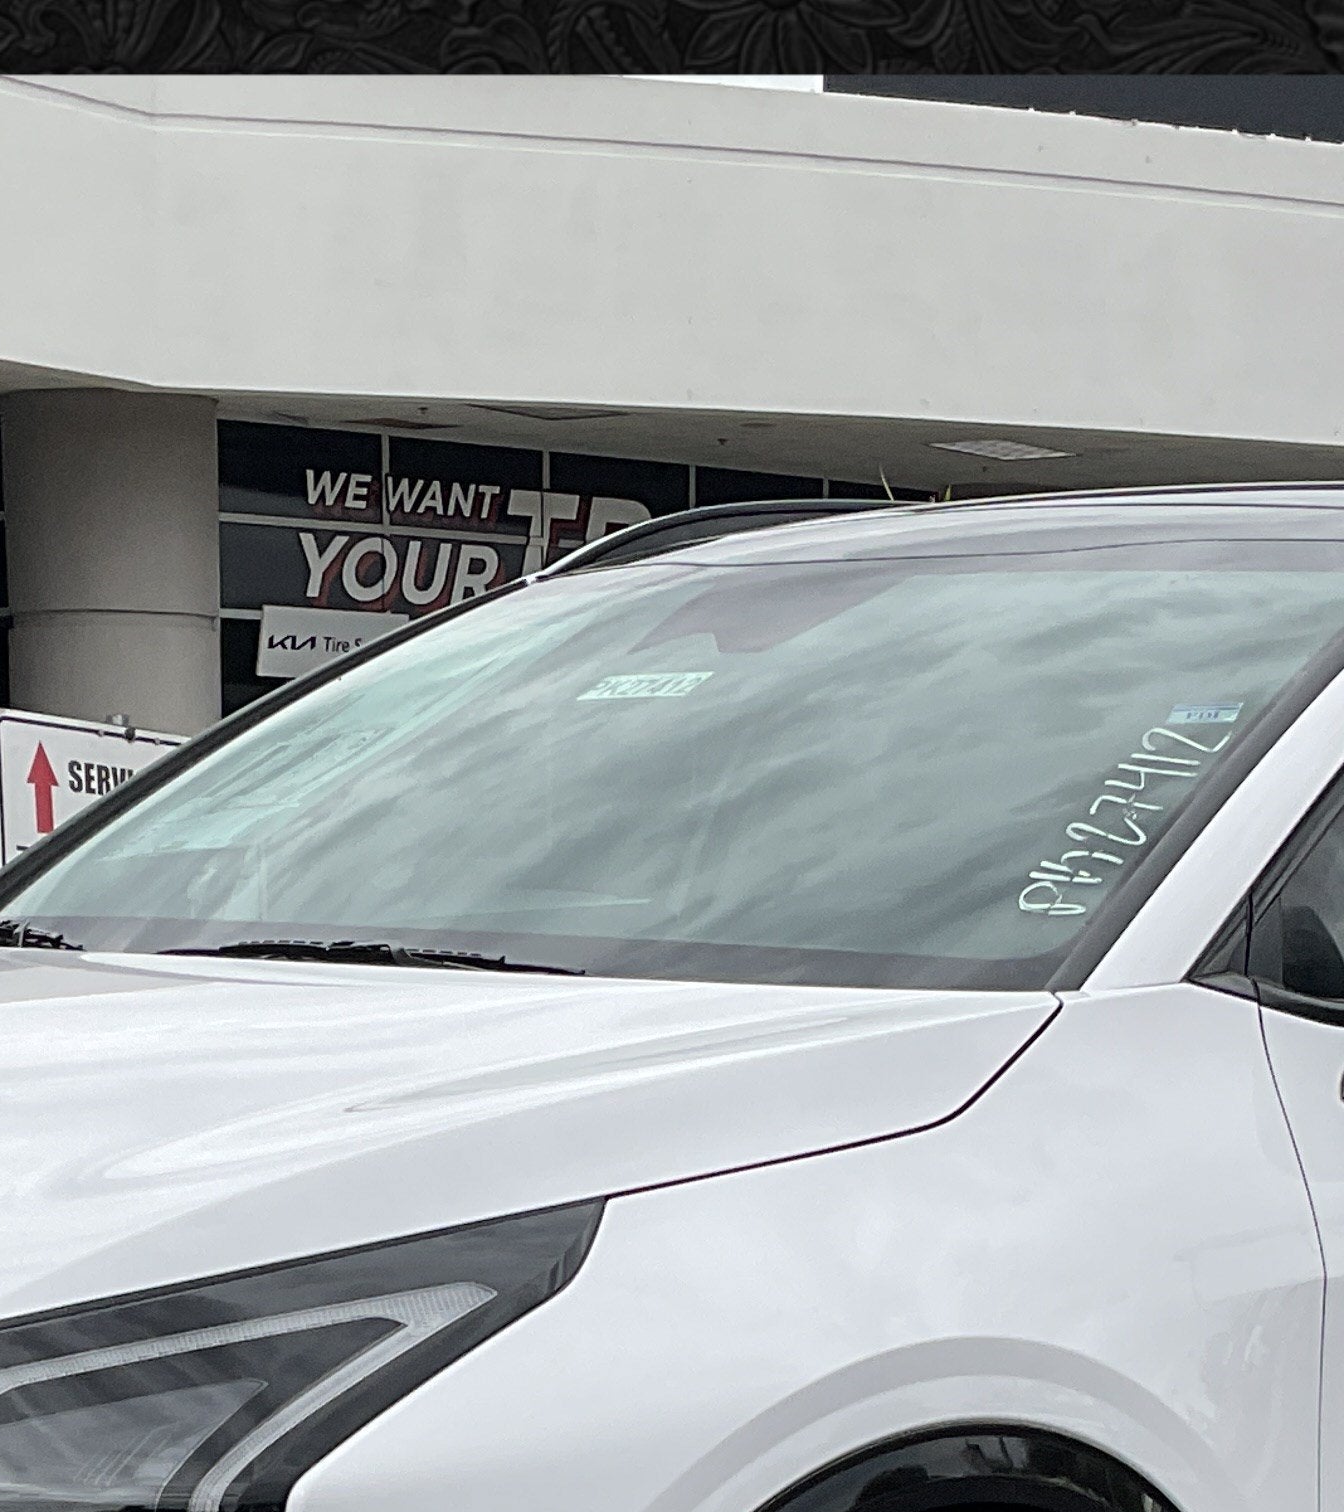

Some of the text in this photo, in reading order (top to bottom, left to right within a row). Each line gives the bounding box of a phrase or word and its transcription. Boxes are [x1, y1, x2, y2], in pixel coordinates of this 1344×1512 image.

[306, 469, 501, 519] WE WANT
[298, 533, 499, 606] YOUR
[268, 634, 317, 650] KIA
[323, 636, 351, 652] Tire
[68, 760, 134, 796] SERV
